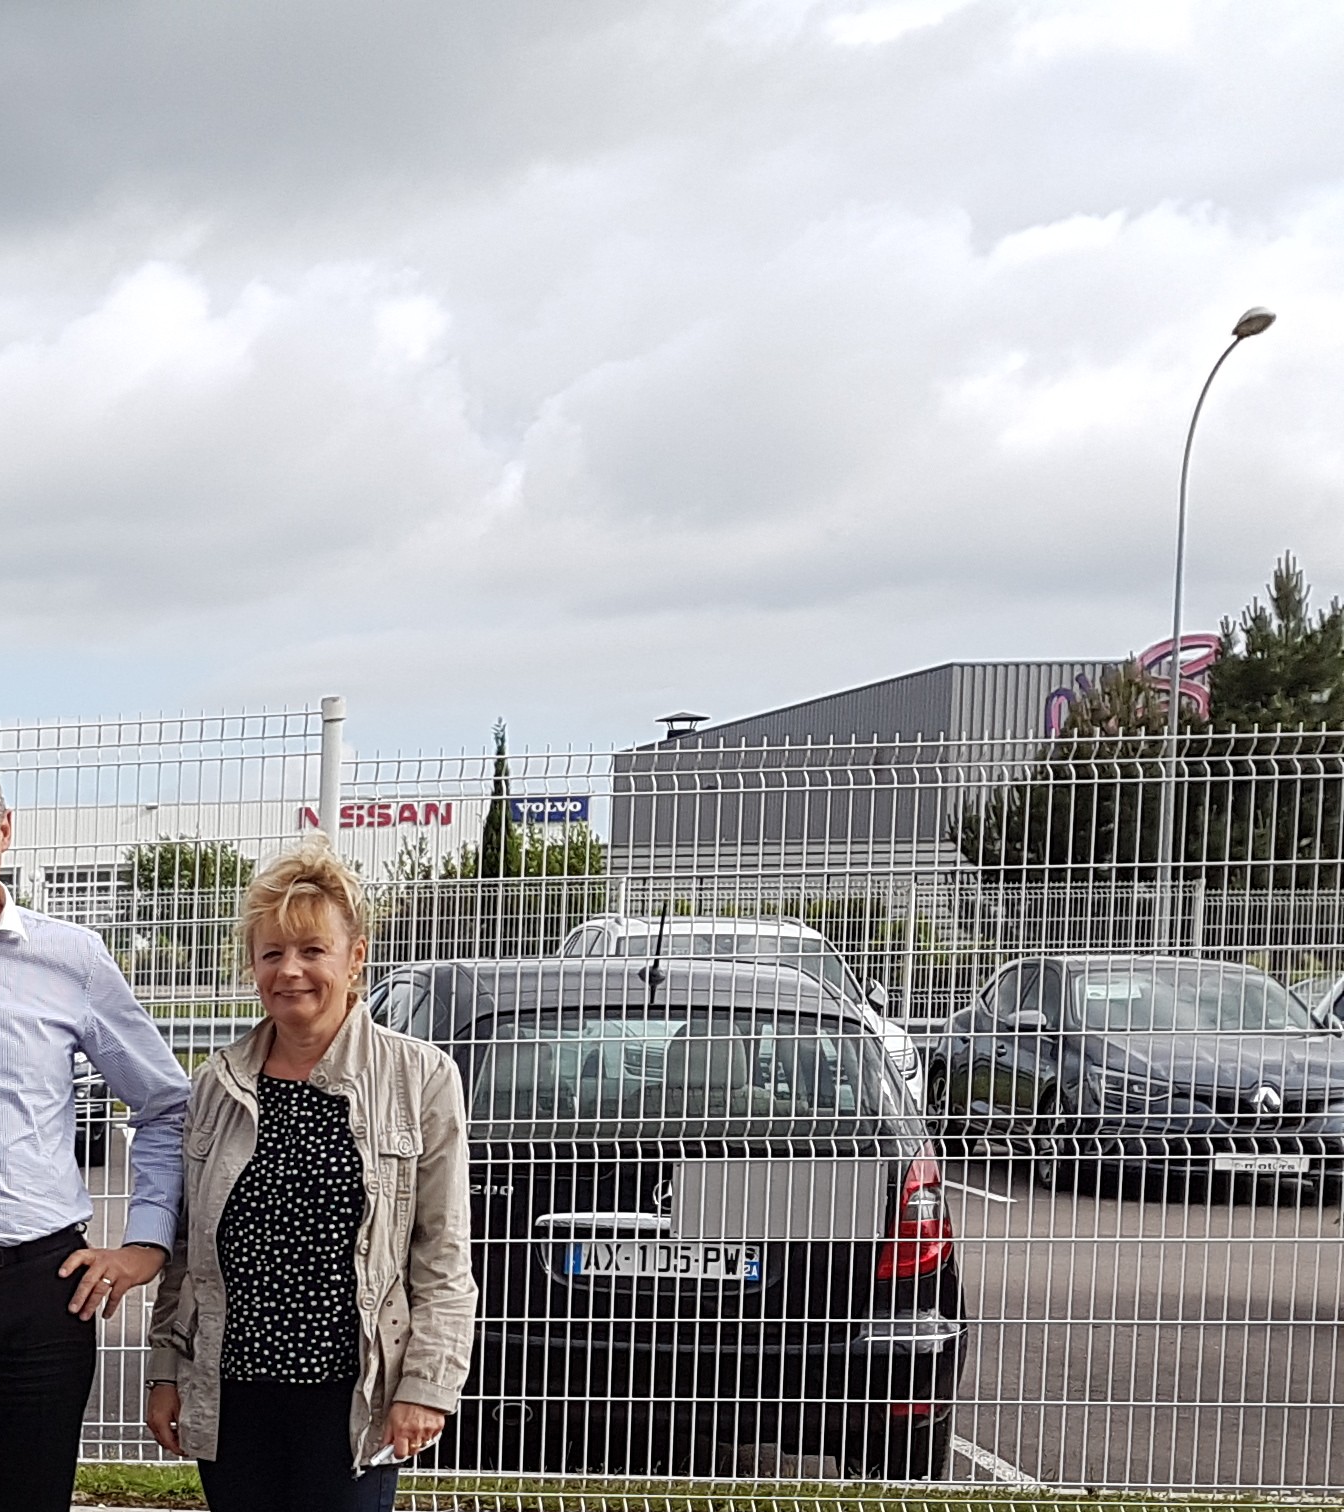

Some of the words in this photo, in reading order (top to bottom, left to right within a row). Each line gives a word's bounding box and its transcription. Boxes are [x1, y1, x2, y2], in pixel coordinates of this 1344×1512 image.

[298, 802, 452, 829] NSSAN
[515, 801, 582, 813] VOLVO
[584, 1243, 740, 1275] AX-105-PW
